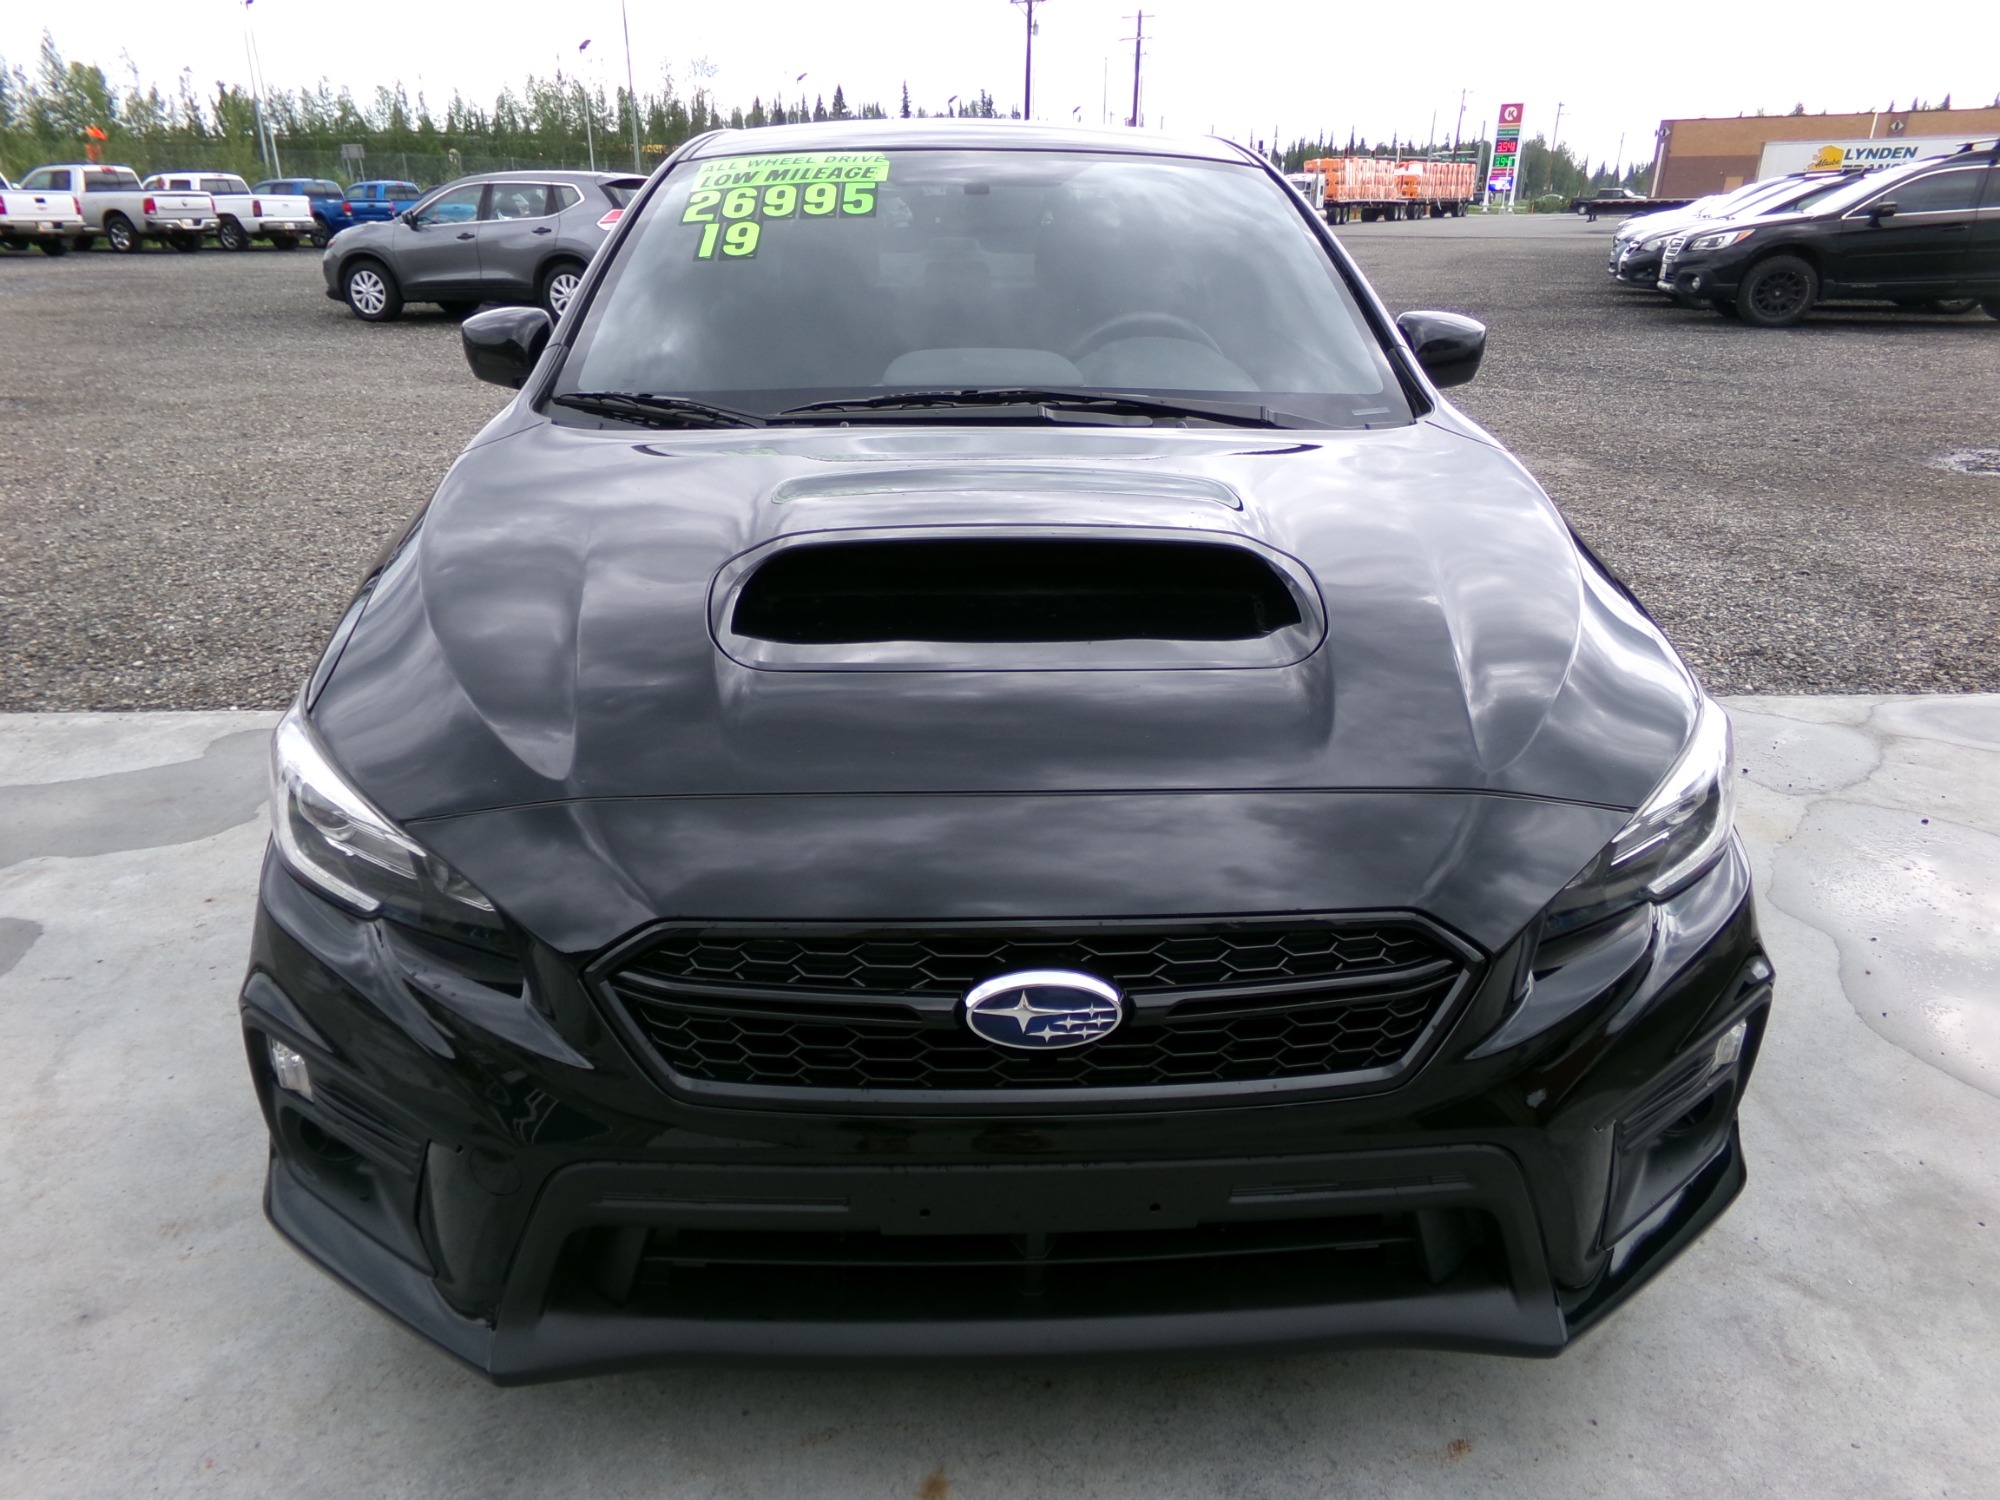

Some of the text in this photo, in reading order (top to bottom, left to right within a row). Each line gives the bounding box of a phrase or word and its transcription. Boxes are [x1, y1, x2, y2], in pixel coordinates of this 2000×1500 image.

[703, 155, 884, 173] ALL WHEEL DRIVE
[1844, 147, 1918, 160] LYNDEN
[700, 166, 876, 188] LOW MILEAGE
[682, 182, 876, 223] 26995
[698, 221, 760, 258] 19
